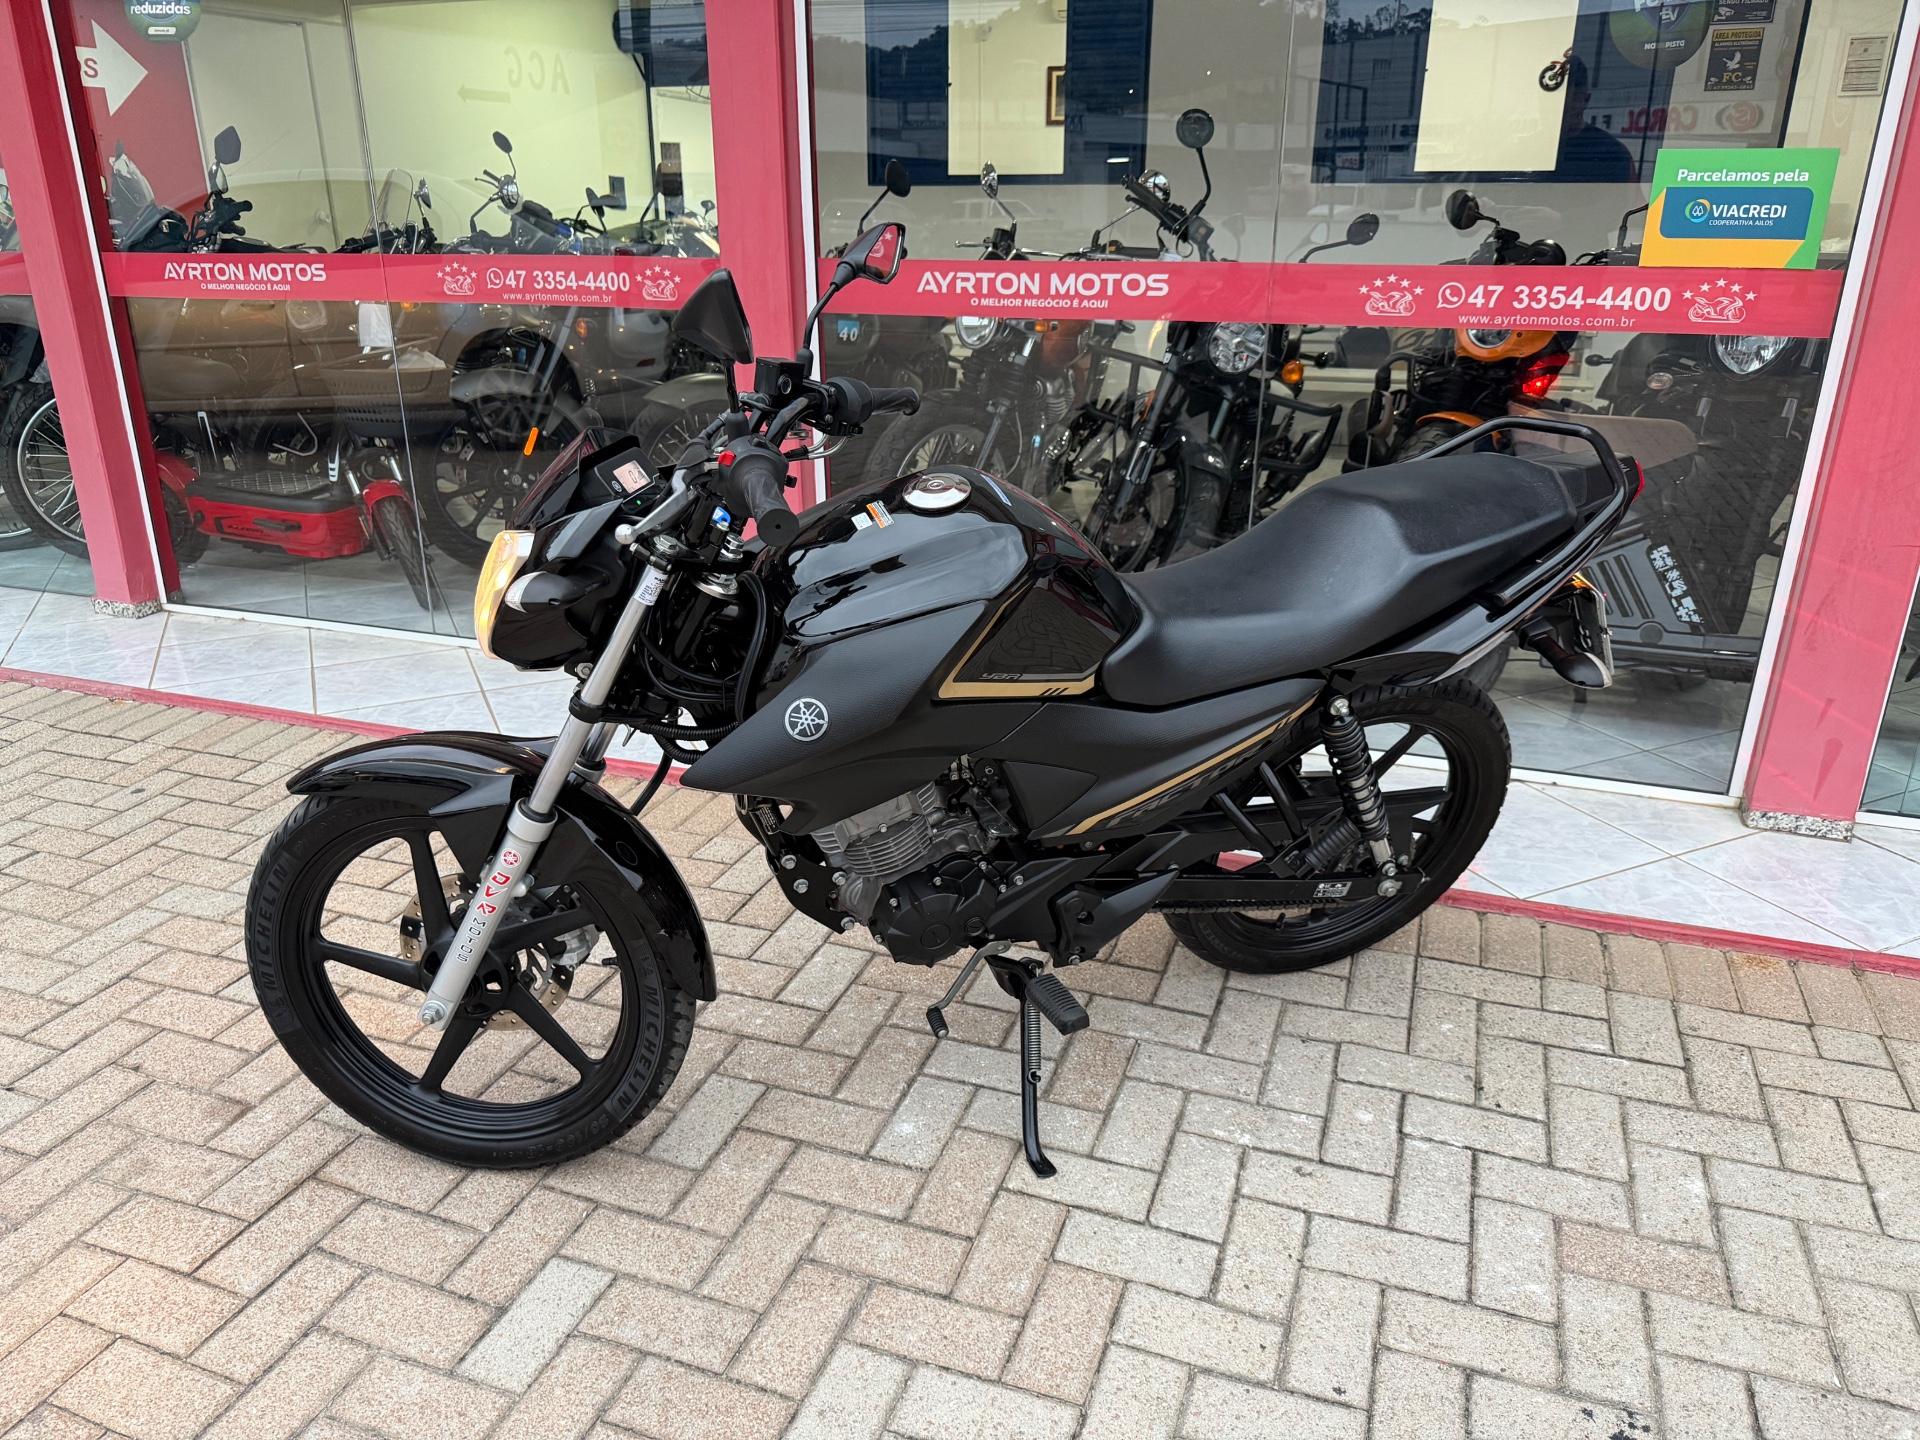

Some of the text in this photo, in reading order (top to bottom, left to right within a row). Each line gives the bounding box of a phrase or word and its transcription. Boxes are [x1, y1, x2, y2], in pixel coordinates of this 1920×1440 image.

[130, 2, 191, 15] reduzidas
[1677, 169, 1809, 184] Parcelamos pela
[1712, 205, 1787, 218] VIACREDI
[164, 262, 327, 282] AYRTON MOTOS
[505, 269, 631, 292] 47 3354-4400
[207, 283, 235, 291] MELHOR
[235, 282, 266, 291] NEGÓCIO
[272, 283, 291, 292] AQUI
[916, 271, 1169, 297] AYRTON MOTOS
[502, 292, 612, 303] www.ayrtonmotos.com.br
[970, 297, 1109, 309] O MELHOR NEGÓCIO É AQUI
[1467, 284, 1672, 312] 47 3354-4400
[1458, 314, 1636, 328] www.ayrtonmotos.com.br
[256, 862, 289, 991] MICHELIN
[456, 917, 487, 963] MOTOS
[616, 984, 662, 1112] MICHELIN
